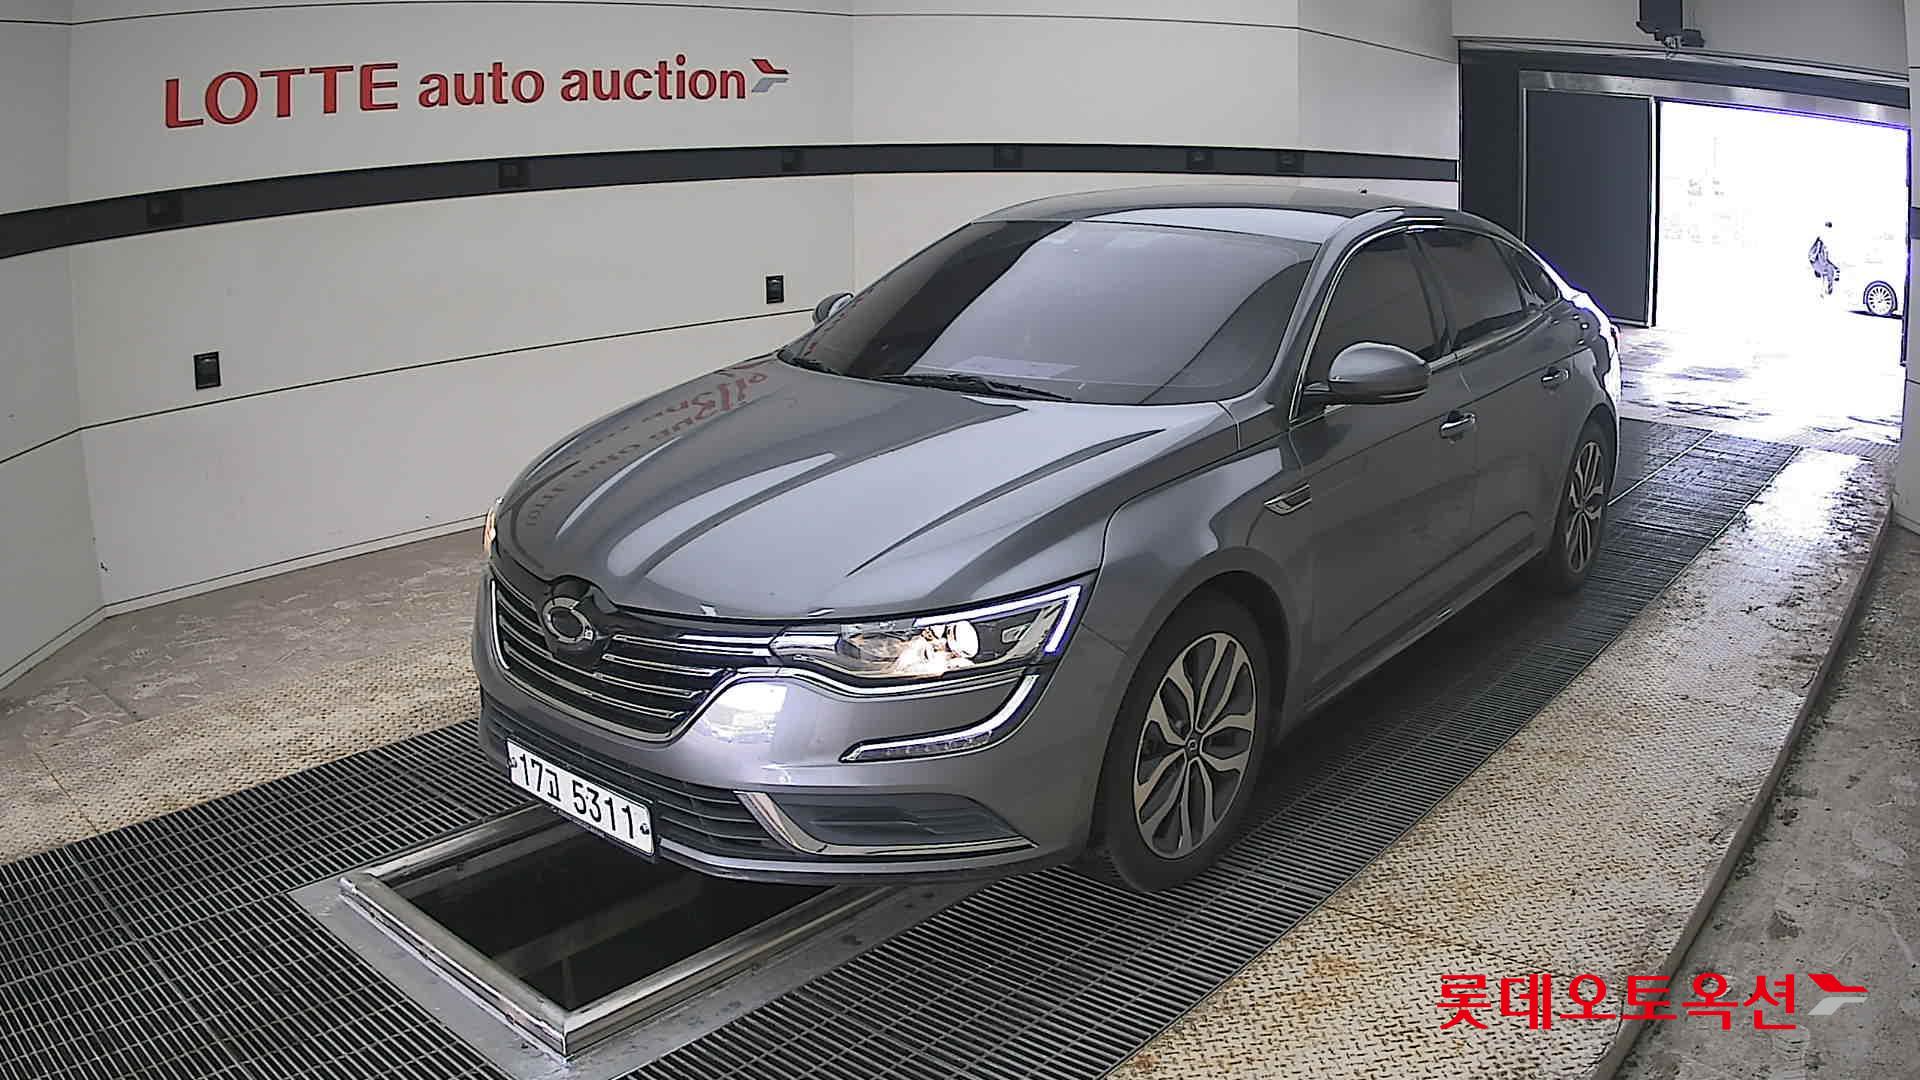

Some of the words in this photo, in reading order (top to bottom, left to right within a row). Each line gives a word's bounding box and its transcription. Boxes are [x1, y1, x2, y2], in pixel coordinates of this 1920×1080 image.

[164, 62, 399, 128] LOTTE
[418, 62, 546, 108] auto
[560, 54, 747, 101] auction
[520, 753, 561, 802] 17고
[572, 779, 634, 839] 5311
